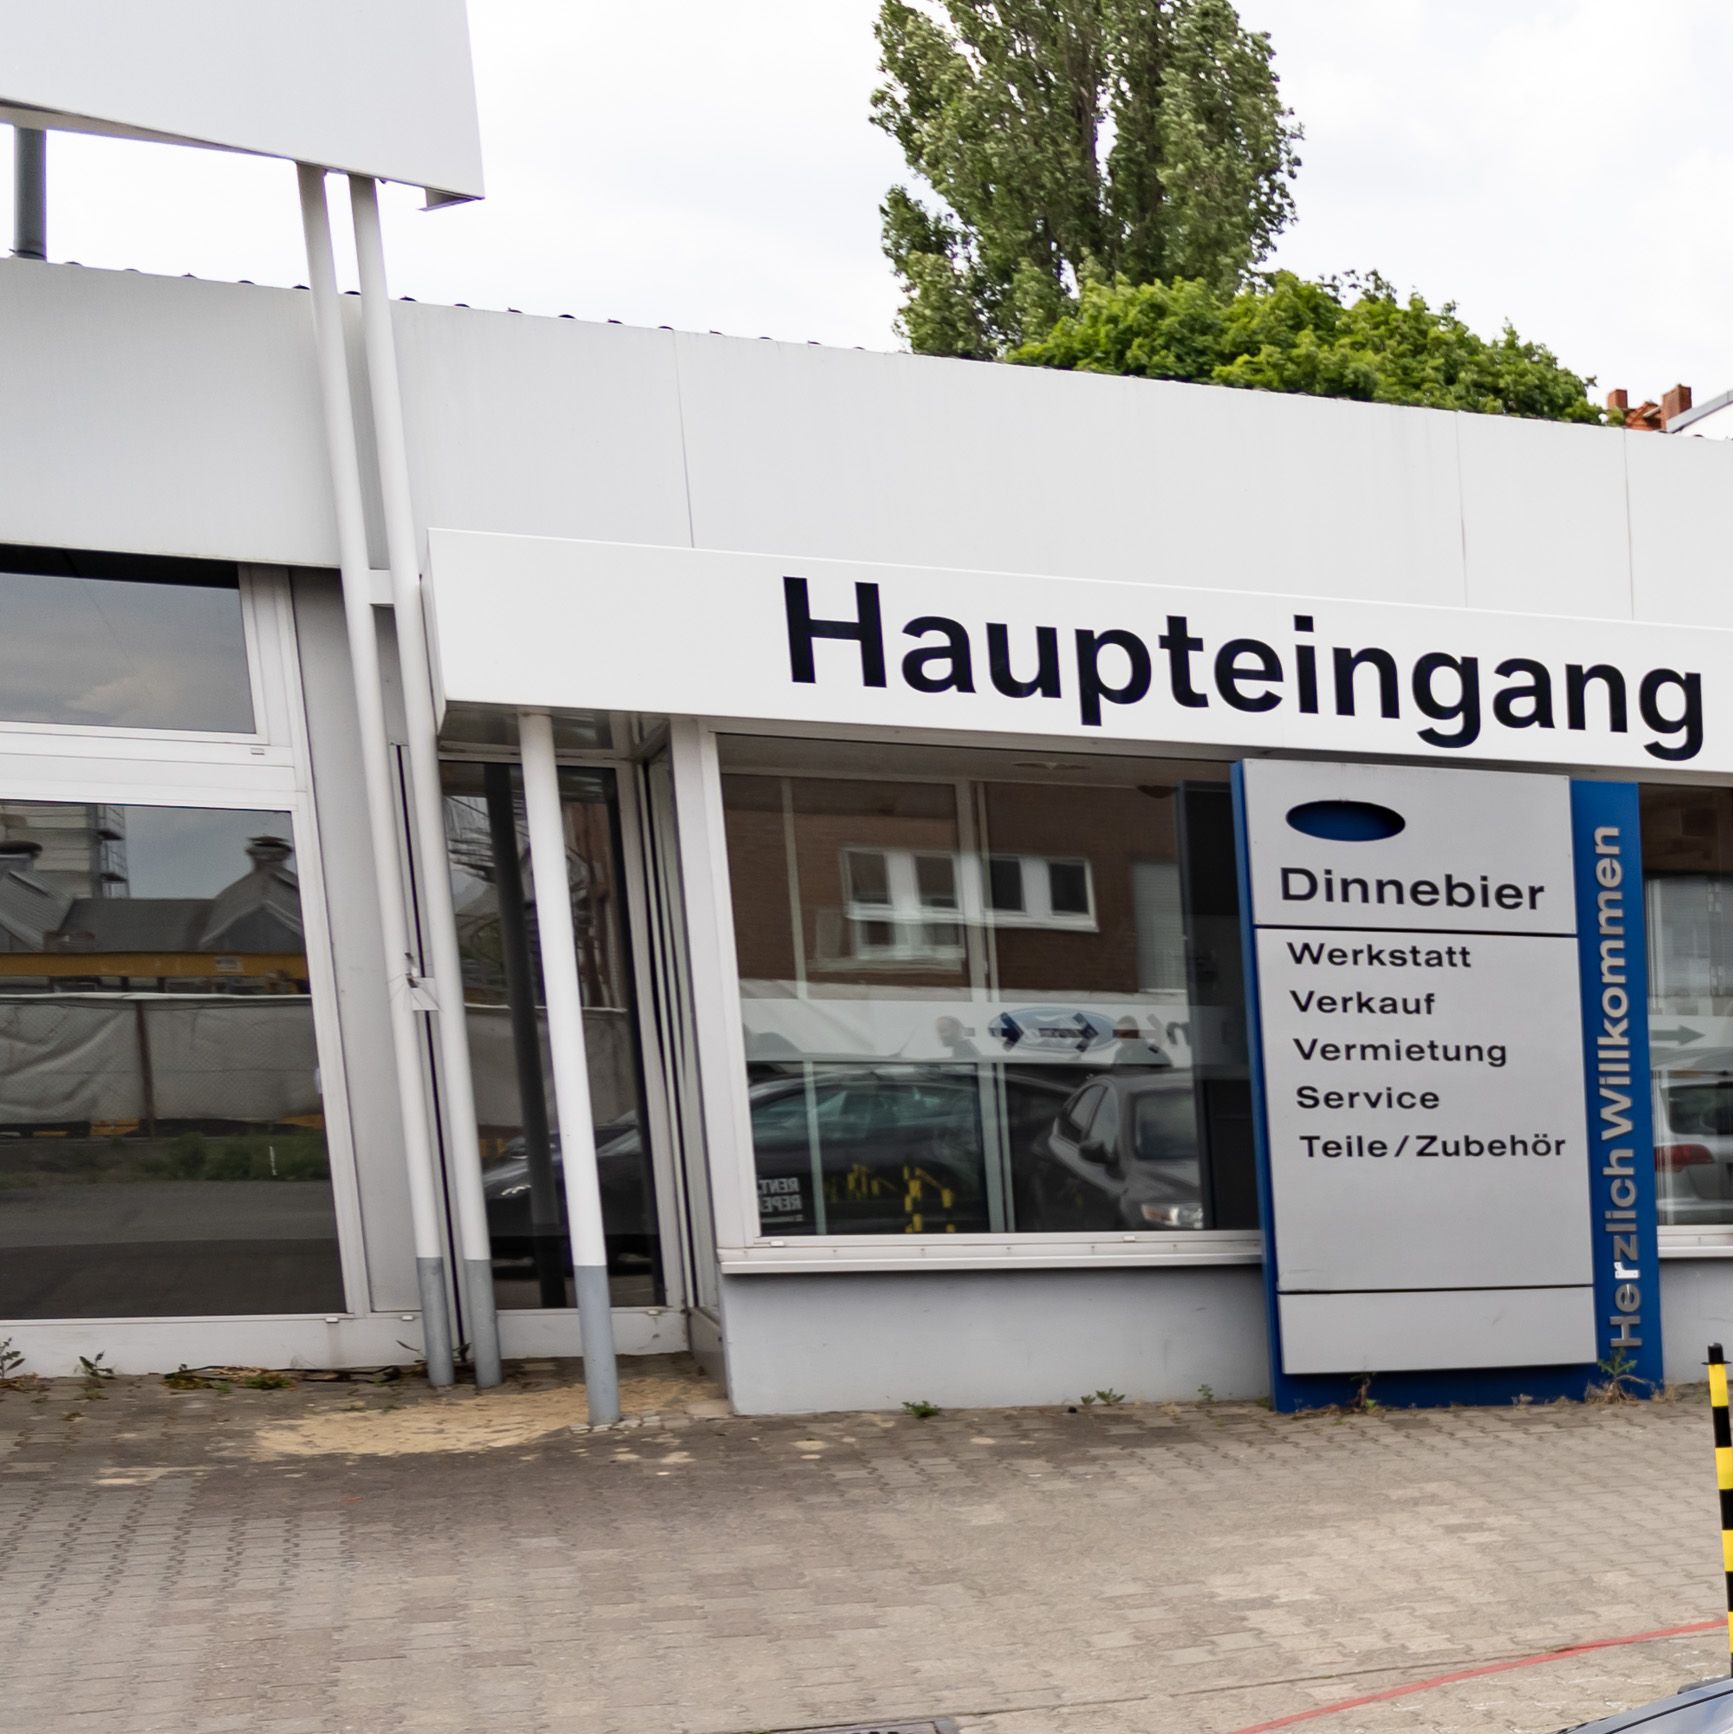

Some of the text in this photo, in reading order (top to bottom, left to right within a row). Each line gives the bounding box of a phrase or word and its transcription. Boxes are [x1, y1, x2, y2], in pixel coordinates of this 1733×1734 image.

[783, 576, 1704, 761] Haupteingang
[1281, 867, 1545, 910] Dinnebier
[1287, 942, 1472, 968] Werkstatt
[1289, 990, 1435, 1015] Verkauf
[1293, 1038, 1507, 1068] Vermietung
[1296, 1085, 1440, 1110] Service
[1593, 826, 1642, 1348] Herzlich Willkommen
